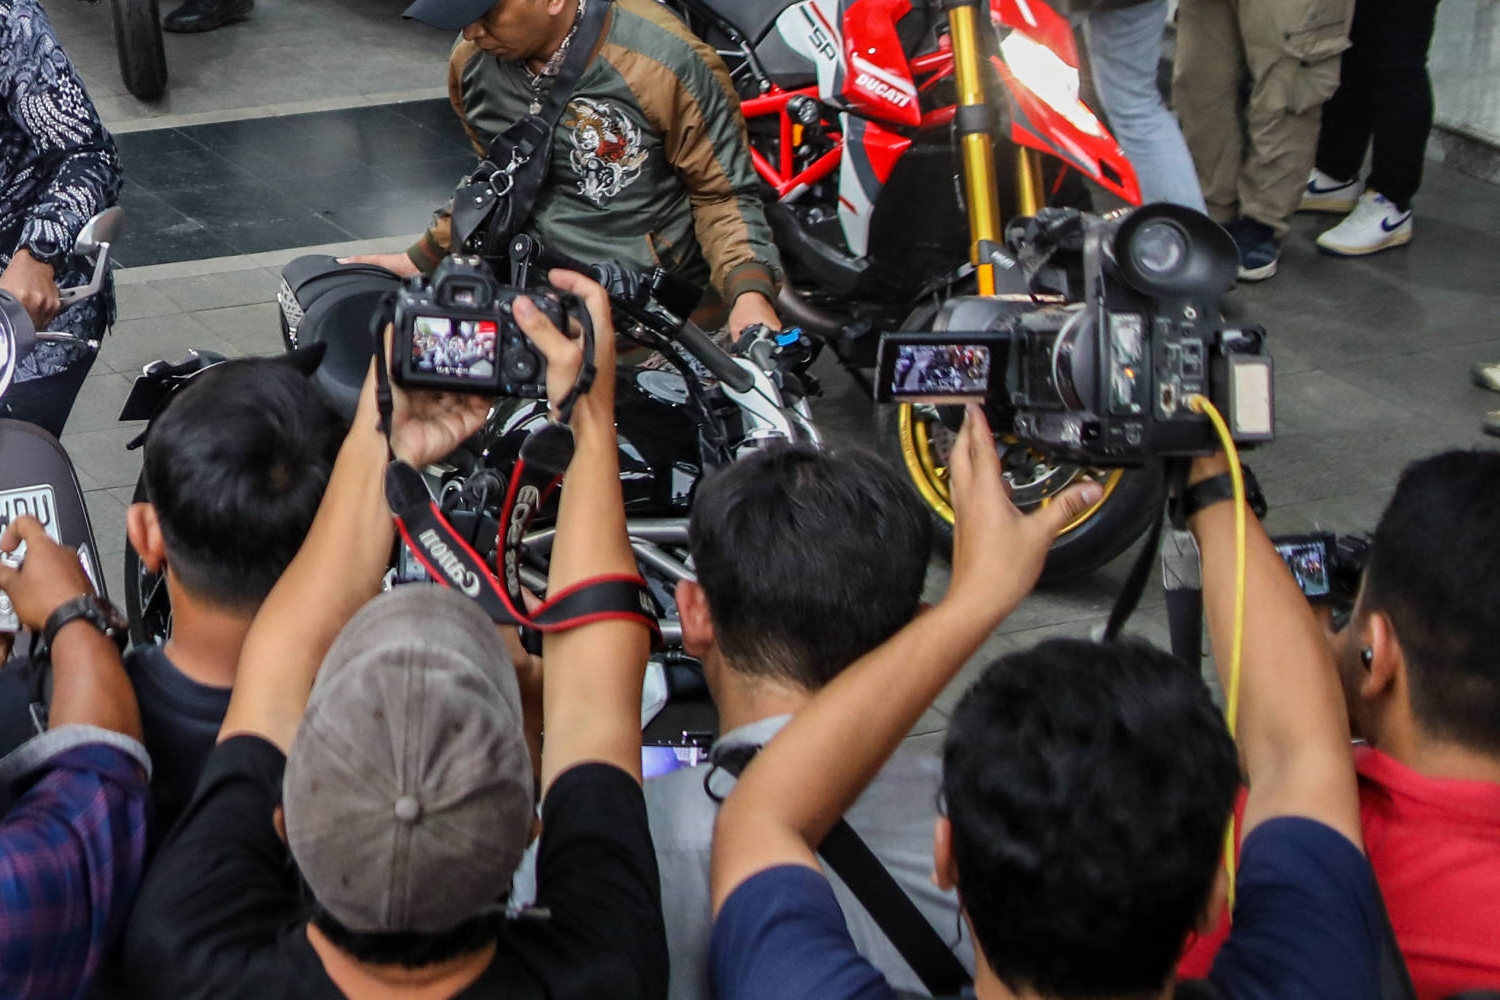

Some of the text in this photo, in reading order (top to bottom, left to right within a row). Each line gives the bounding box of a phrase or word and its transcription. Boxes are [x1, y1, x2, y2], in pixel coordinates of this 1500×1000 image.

[808, 25, 837, 61] SP
[855, 73, 911, 108] DUCATI
[506, 485, 540, 546] EOS
[418, 528, 481, 598] Canon
